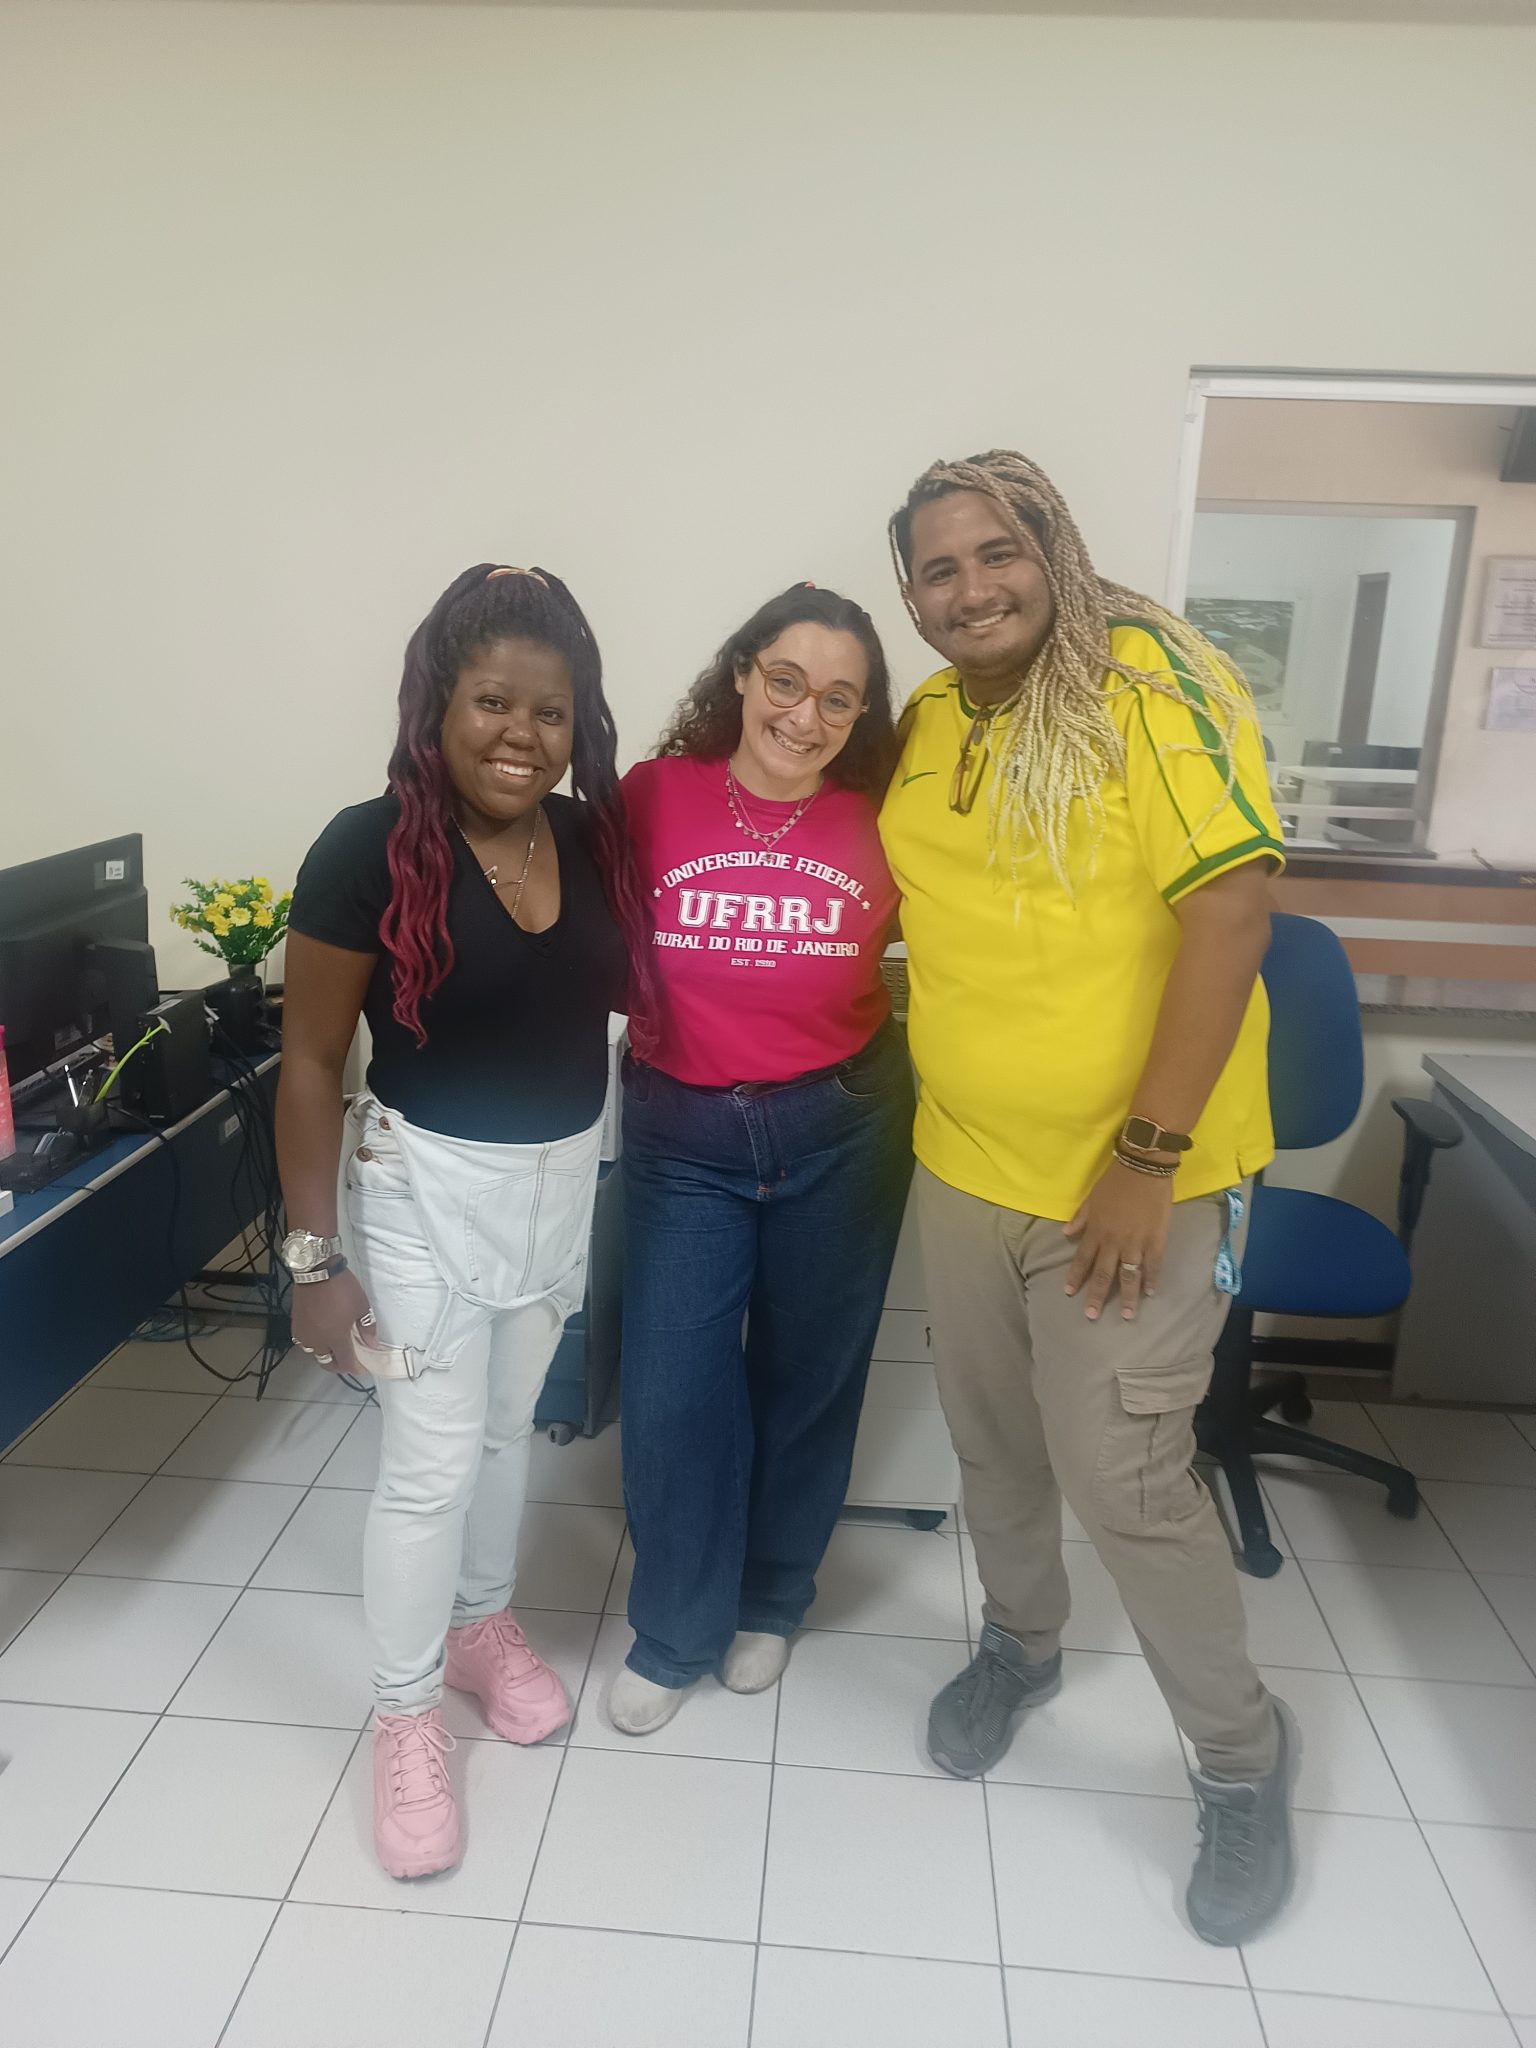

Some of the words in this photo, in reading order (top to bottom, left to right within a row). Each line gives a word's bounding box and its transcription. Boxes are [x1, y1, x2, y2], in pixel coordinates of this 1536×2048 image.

[662, 850, 792, 889] UNIVERSIDADE
[795, 856, 866, 901] FEDERAL
[677, 888, 845, 935] UFRRJ
[652, 930, 704, 950] RURAL
[708, 935, 731, 951] DO
[734, 937, 763, 952] RIO
[766, 938, 788, 954] DE
[791, 940, 860, 957] JANEIRO
[730, 957, 754, 967] EST.
